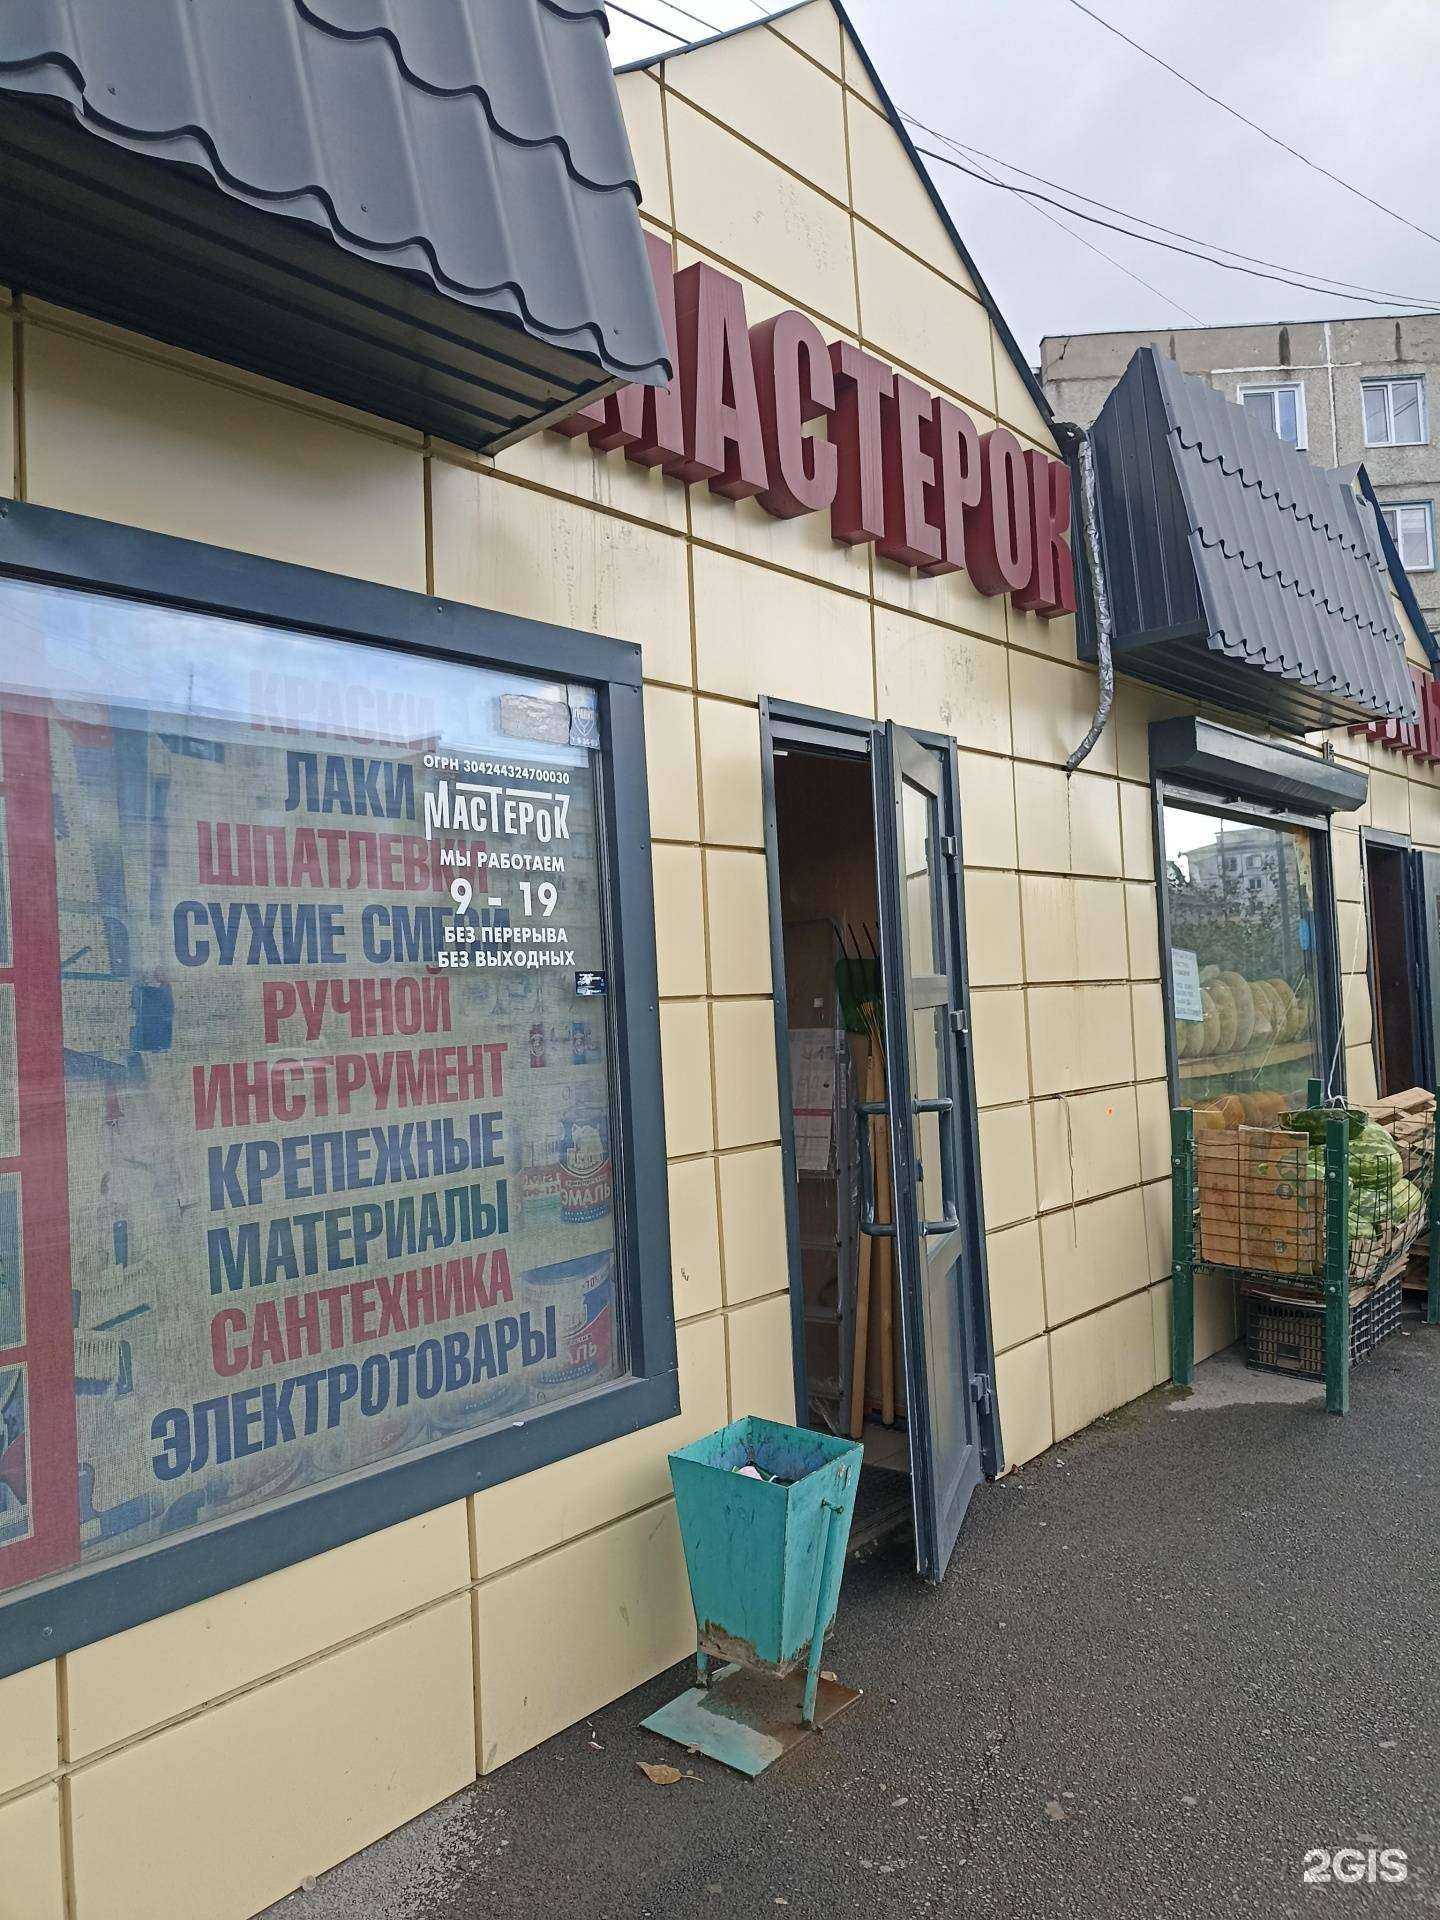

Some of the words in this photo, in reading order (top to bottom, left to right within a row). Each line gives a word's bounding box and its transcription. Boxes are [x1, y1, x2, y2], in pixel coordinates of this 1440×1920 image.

[250, 670, 438, 751] КРАСКИ
[284, 750, 415, 820] ЛАКИ
[424, 754, 459, 772] ОГРН
[464, 759, 570, 784] 304244324700030
[424, 780, 570, 843] МАСТЕРОК
[440, 849, 471, 867] МЫ
[477, 852, 565, 872] РАБОТАЕМ
[450, 877, 472, 915] 9
[488, 896, 502, 906] -
[519, 881, 558, 916] 19
[173, 900, 347, 967] СУХИЕ
[438, 951, 469, 968] БЕЗ
[475, 950, 575, 969] ВЫХОДНЫХ
[444, 926, 476, 943] БЕЗ
[481, 926, 568, 943] ПЕРЕРЫВА
[263, 965, 452, 1043] РУЧНОЙ
[192, 1043, 508, 1130] ИНСТРУМЕНТ
[207, 1111, 504, 1212] КРЕПЕЖНЫЕ
[207, 1179, 509, 1295] МАТЕРИАЛЫ
[210, 1248, 513, 1377] САНТЕХНИКА
[151, 1305, 557, 1481] ЭЛЕКТРОТОВАРЫ
